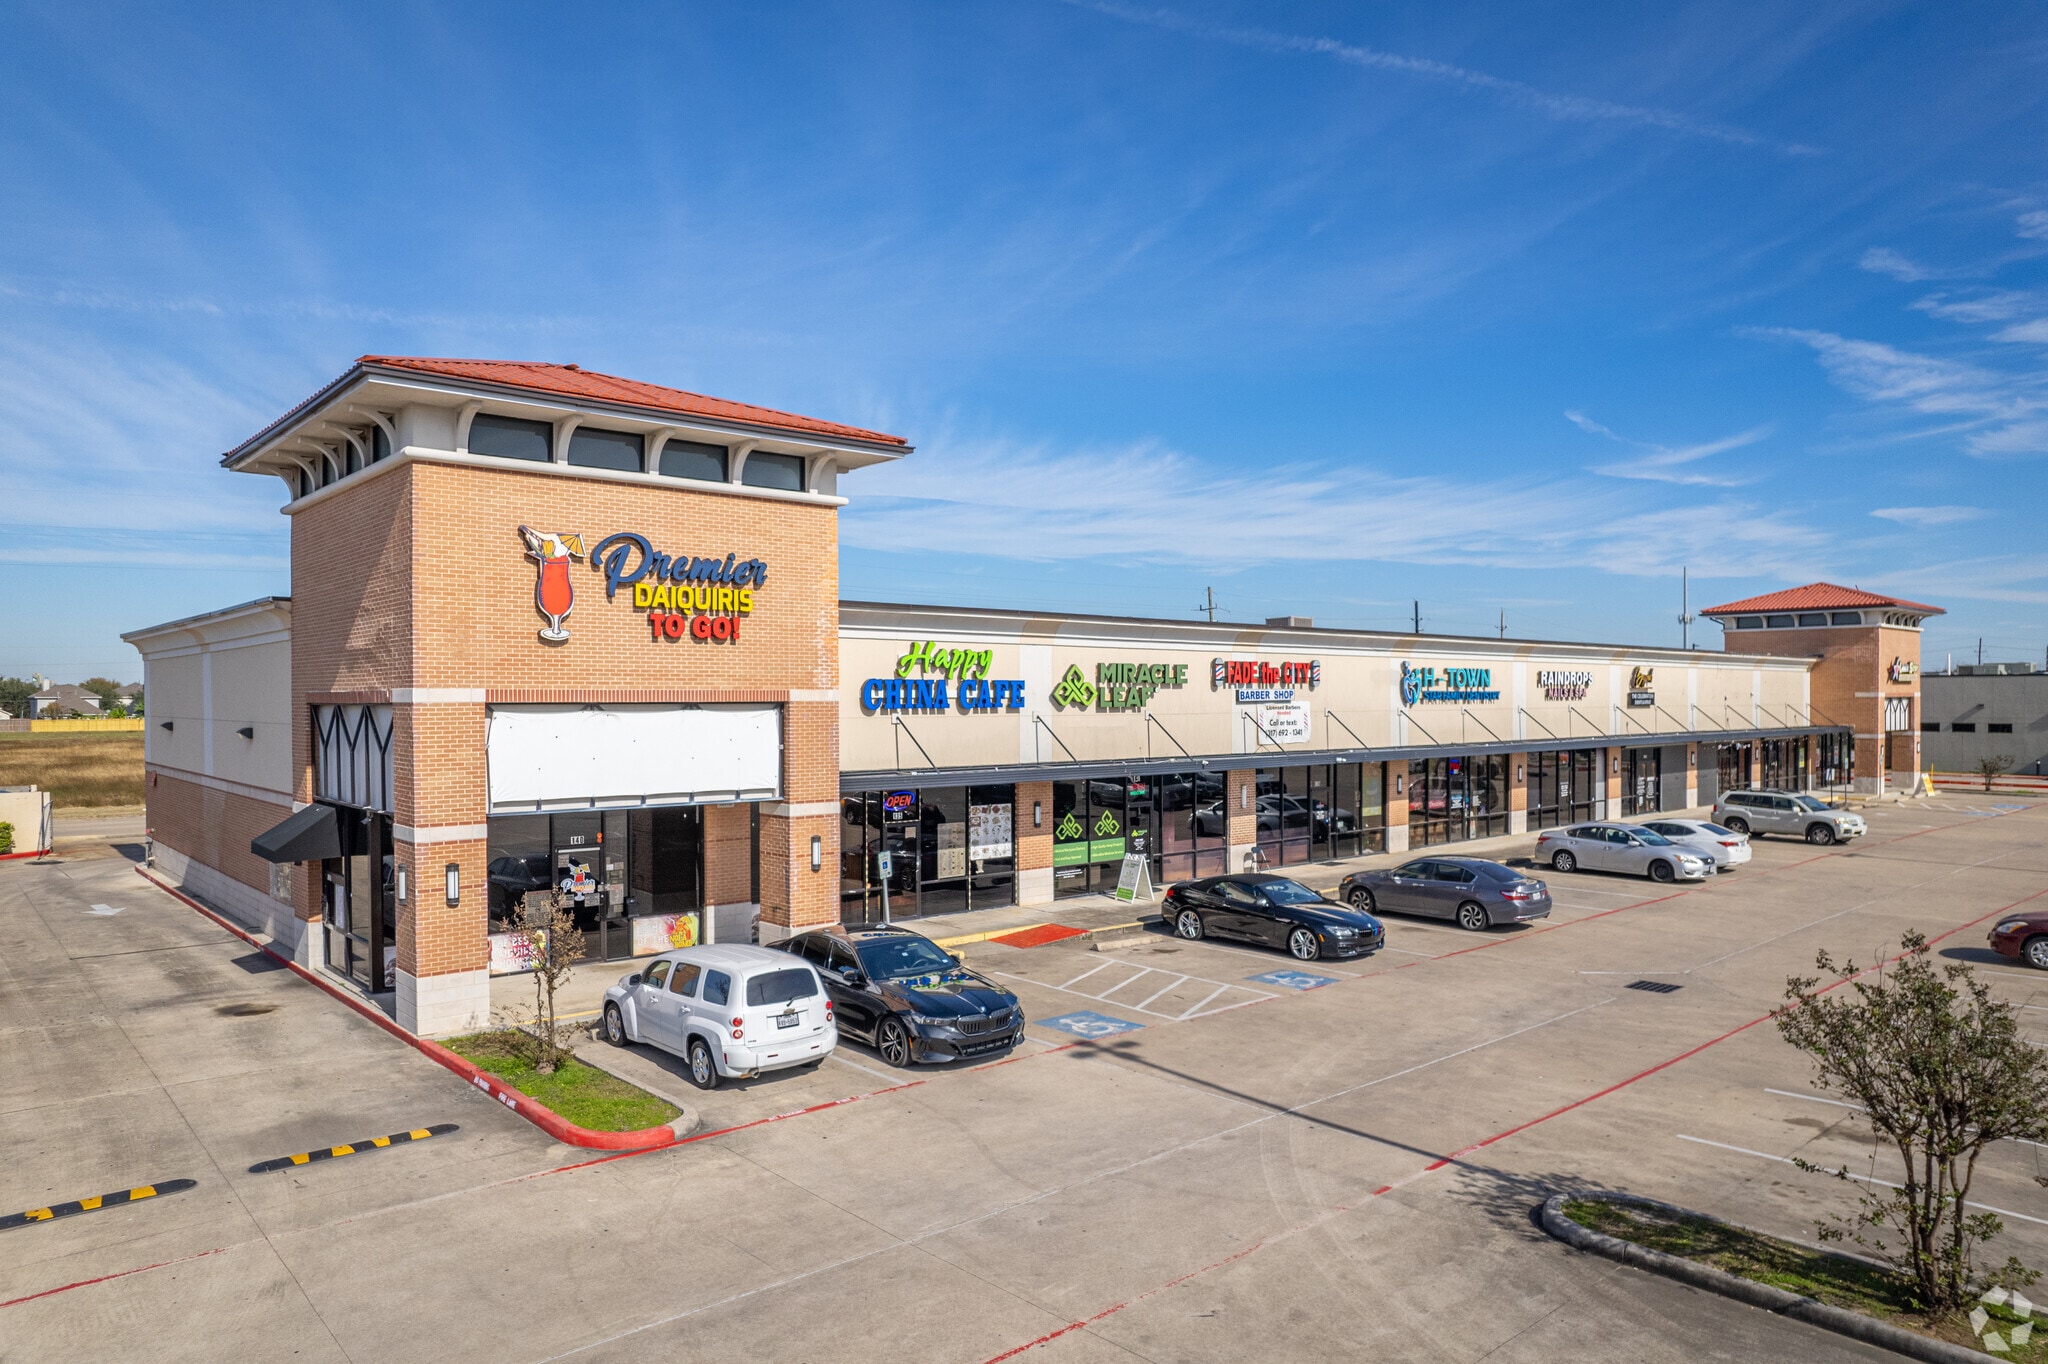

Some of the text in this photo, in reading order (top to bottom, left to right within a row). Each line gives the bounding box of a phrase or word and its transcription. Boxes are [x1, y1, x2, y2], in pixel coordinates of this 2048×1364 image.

[590, 532, 768, 597] Premier
[634, 583, 754, 615] DAIQUIRIS
[650, 613, 741, 640] TO GO!
[898, 641, 993, 680] Happy
[1100, 663, 1188, 684] MIRACLE
[1227, 661, 1311, 684] FADE the CITY
[1541, 671, 1594, 685] RAINDROPS
[863, 678, 1026, 711] CHINA CAFE
[1100, 687, 1151, 708] LEAF
[1240, 690, 1294, 700] BARBER SHOP
[1466, 691, 1500, 700] DENTISTRY
[1548, 688, 1568, 698] NAILS
[1575, 688, 1587, 698] SPA
[887, 795, 912, 807] OPEN
[571, 836, 584, 845] 140
